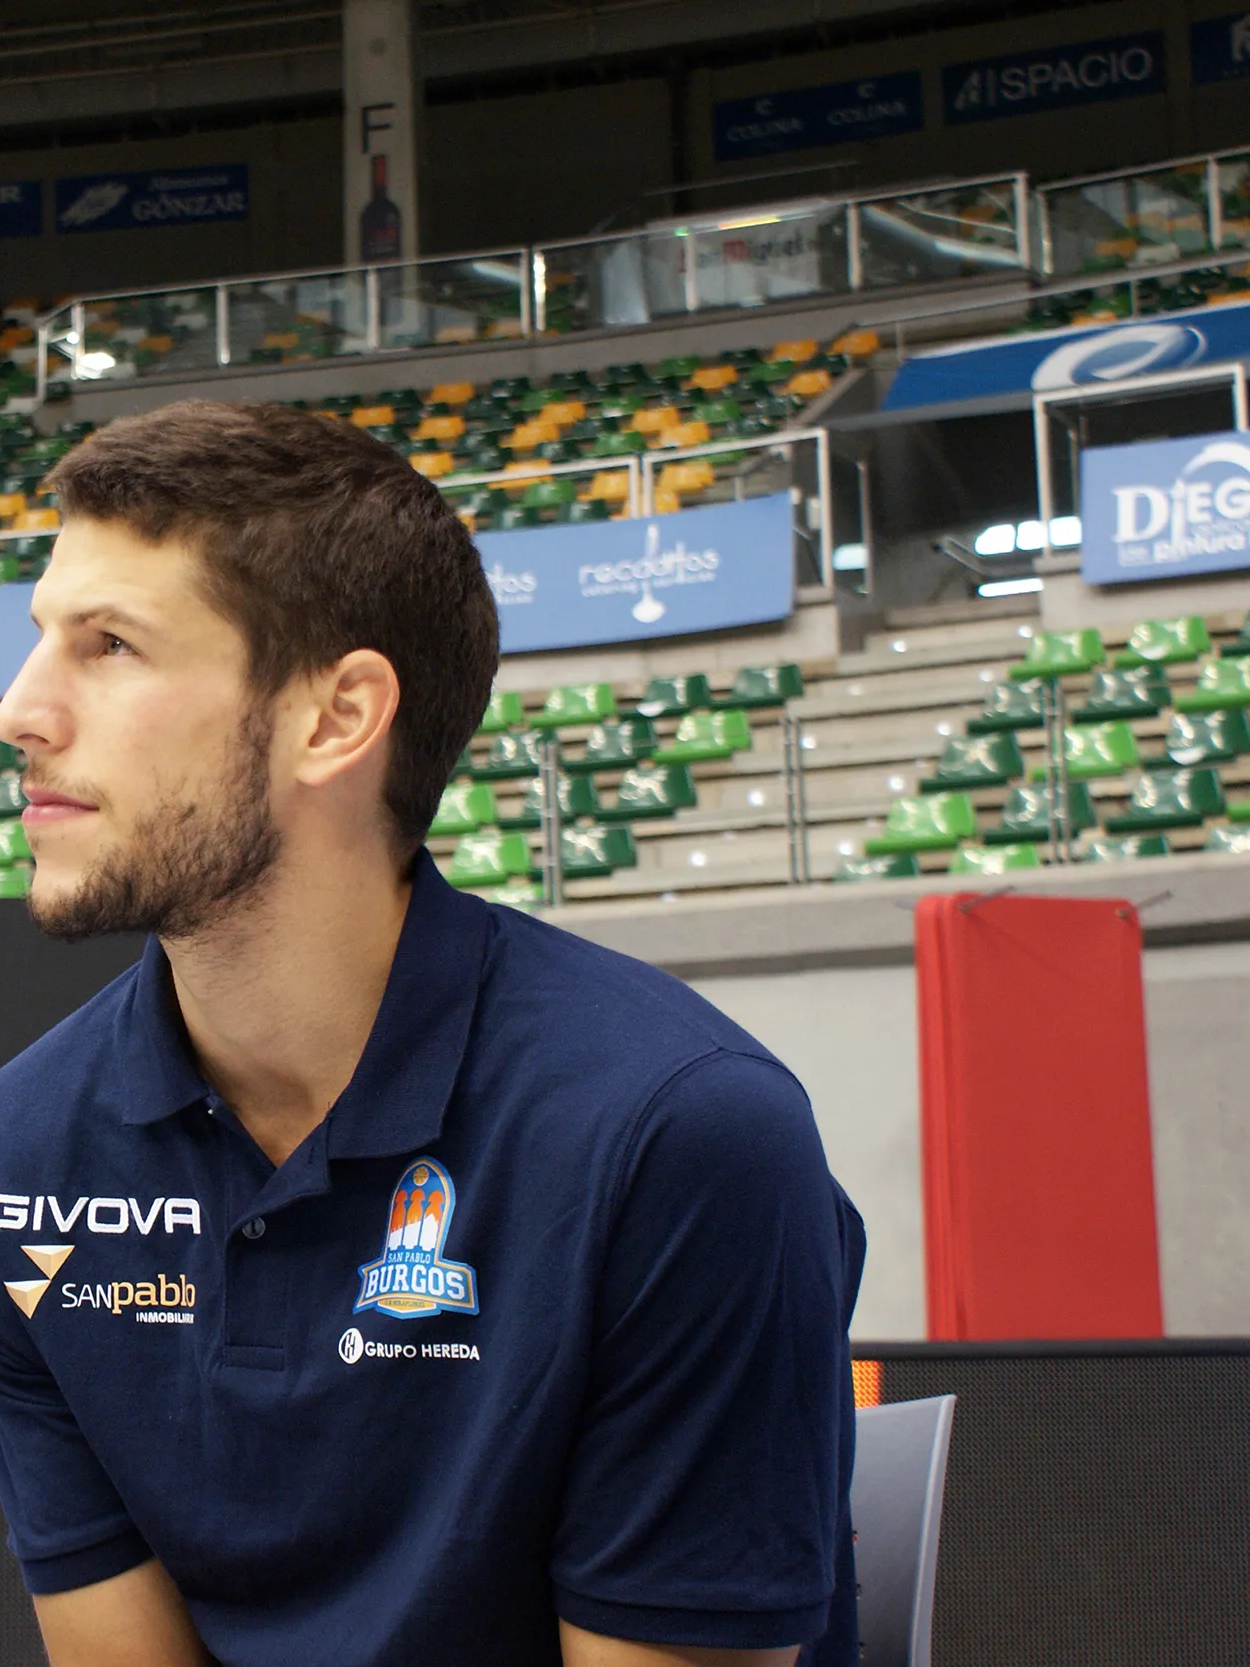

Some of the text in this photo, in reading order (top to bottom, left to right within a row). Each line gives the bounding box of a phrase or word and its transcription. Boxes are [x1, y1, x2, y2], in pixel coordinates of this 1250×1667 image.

[361, 103, 395, 153] F
[388, 1252, 431, 1264] SAN PABLO
[365, 1263, 466, 1300] BURGOS
[365, 1341, 417, 1359] GRUPO
[421, 1343, 480, 1361] HEREDA
